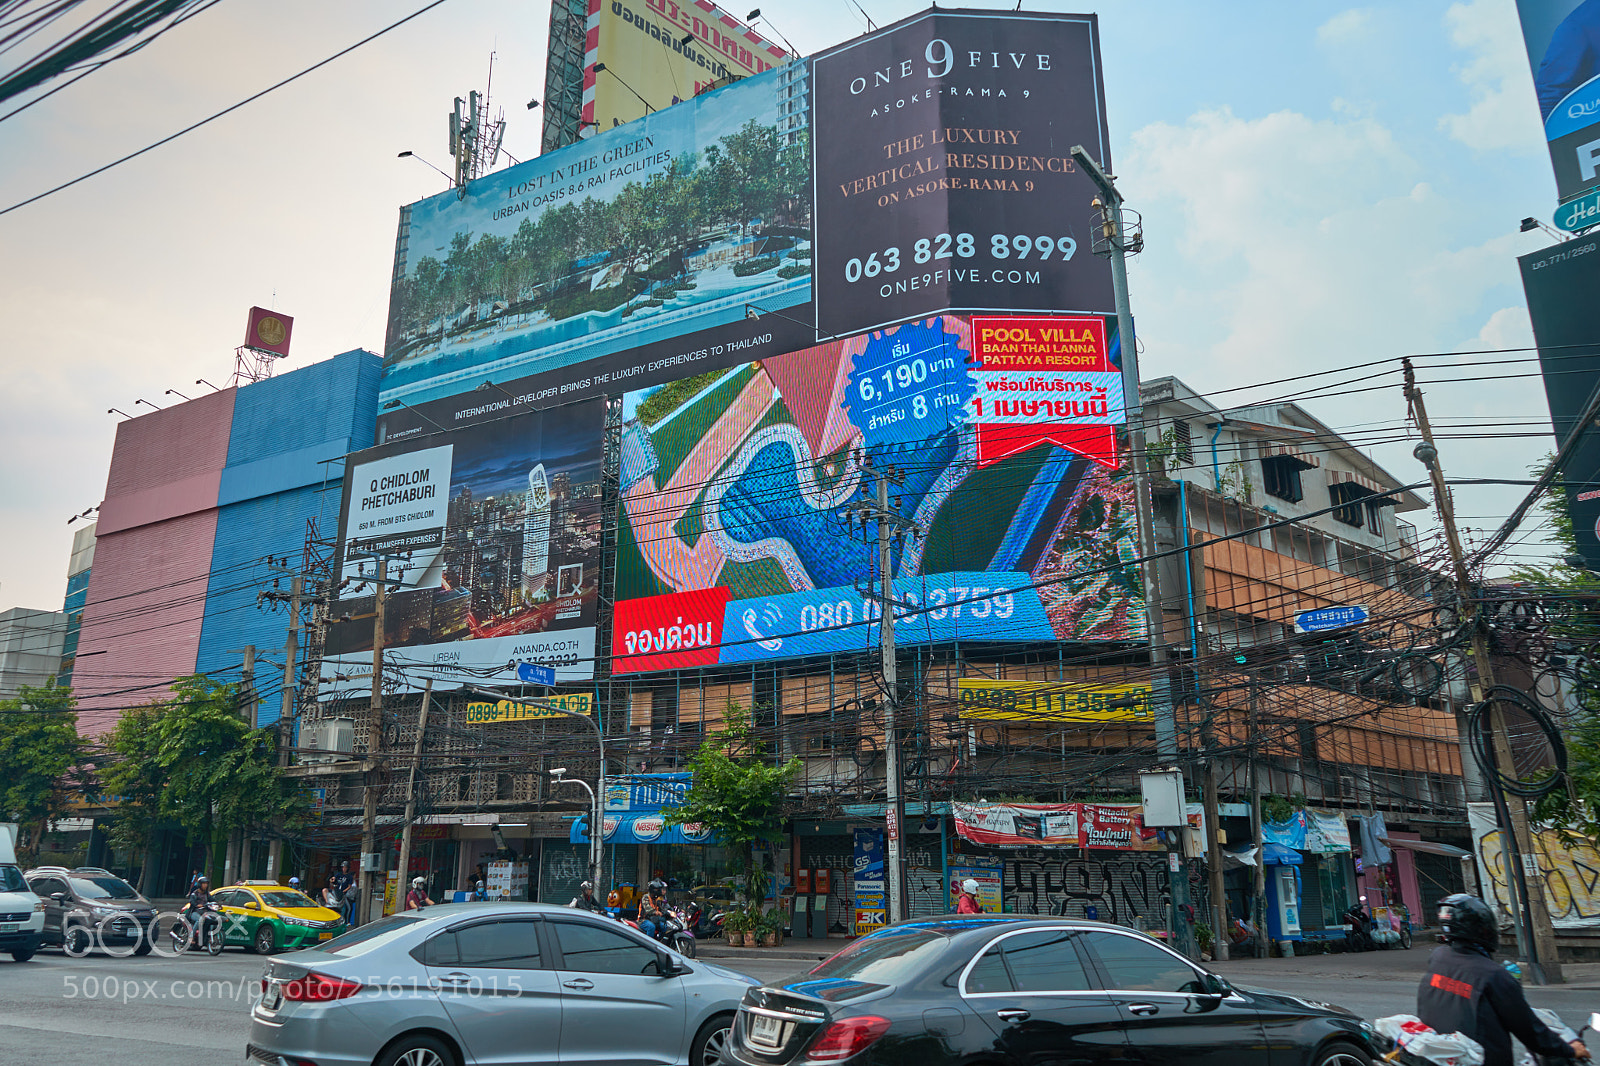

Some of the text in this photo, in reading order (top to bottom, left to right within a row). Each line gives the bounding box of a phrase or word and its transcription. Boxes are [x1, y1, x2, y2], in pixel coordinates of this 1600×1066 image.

[850, 39, 1051, 95] ONE 9 FIVE
[871, 87, 1030, 118] ASOKE-RAMA 9
[884, 127, 1021, 159] THE LUXURY
[509, 134, 655, 198] LOST IN THE GREEN
[840, 153, 1075, 198] VERTICAL RESIDENCE
[493, 150, 671, 221] URBAN OASIS 8.6 RAI FACILITIES
[878, 178, 1034, 207] ON ASOKE-RAMA 9
[845, 233, 1077, 283] 063 828 8999
[1549, 243, 1597, 264] 771/2560
[880, 269, 1040, 298] ONE9FIVE.COM
[982, 328, 1096, 342] POOL VILLA
[983, 344, 1097, 353] BAAN THAI LANNA
[983, 355, 1097, 365] PATTAYA RESORT
[454, 333, 772, 420] INTERNATIONAL DEVELOPER BRINGS THE LUXURY EXPERIENCES TO THAILAND
[859, 358, 955, 401] 6,190 บาท
[986, 376, 1093, 392] พร้อมให้บริการ
[868, 392, 960, 430] สำหรับ 8 ท่าน
[972, 387, 1109, 417] 1 เมษายนนี้
[370, 468, 430, 493] Q CHIDLOM
[361, 484, 436, 511] PHETCHABURI
[377, 517, 394, 527] FROM
[395, 514, 406, 523] BTS
[407, 510, 434, 521] CHIDLOM
[801, 604, 853, 632] 080
[929, 587, 1015, 619] 3759
[512, 640, 579, 655] ANANDA.CO.TH
[625, 616, 712, 654] จองด่วน
[433, 651, 460, 662] URBAN
[1099, 808, 1129, 816] Hitachi
[1099, 815, 1131, 825] Battery
[855, 856, 870, 867] GS
[858, 912, 884, 923] 3K
